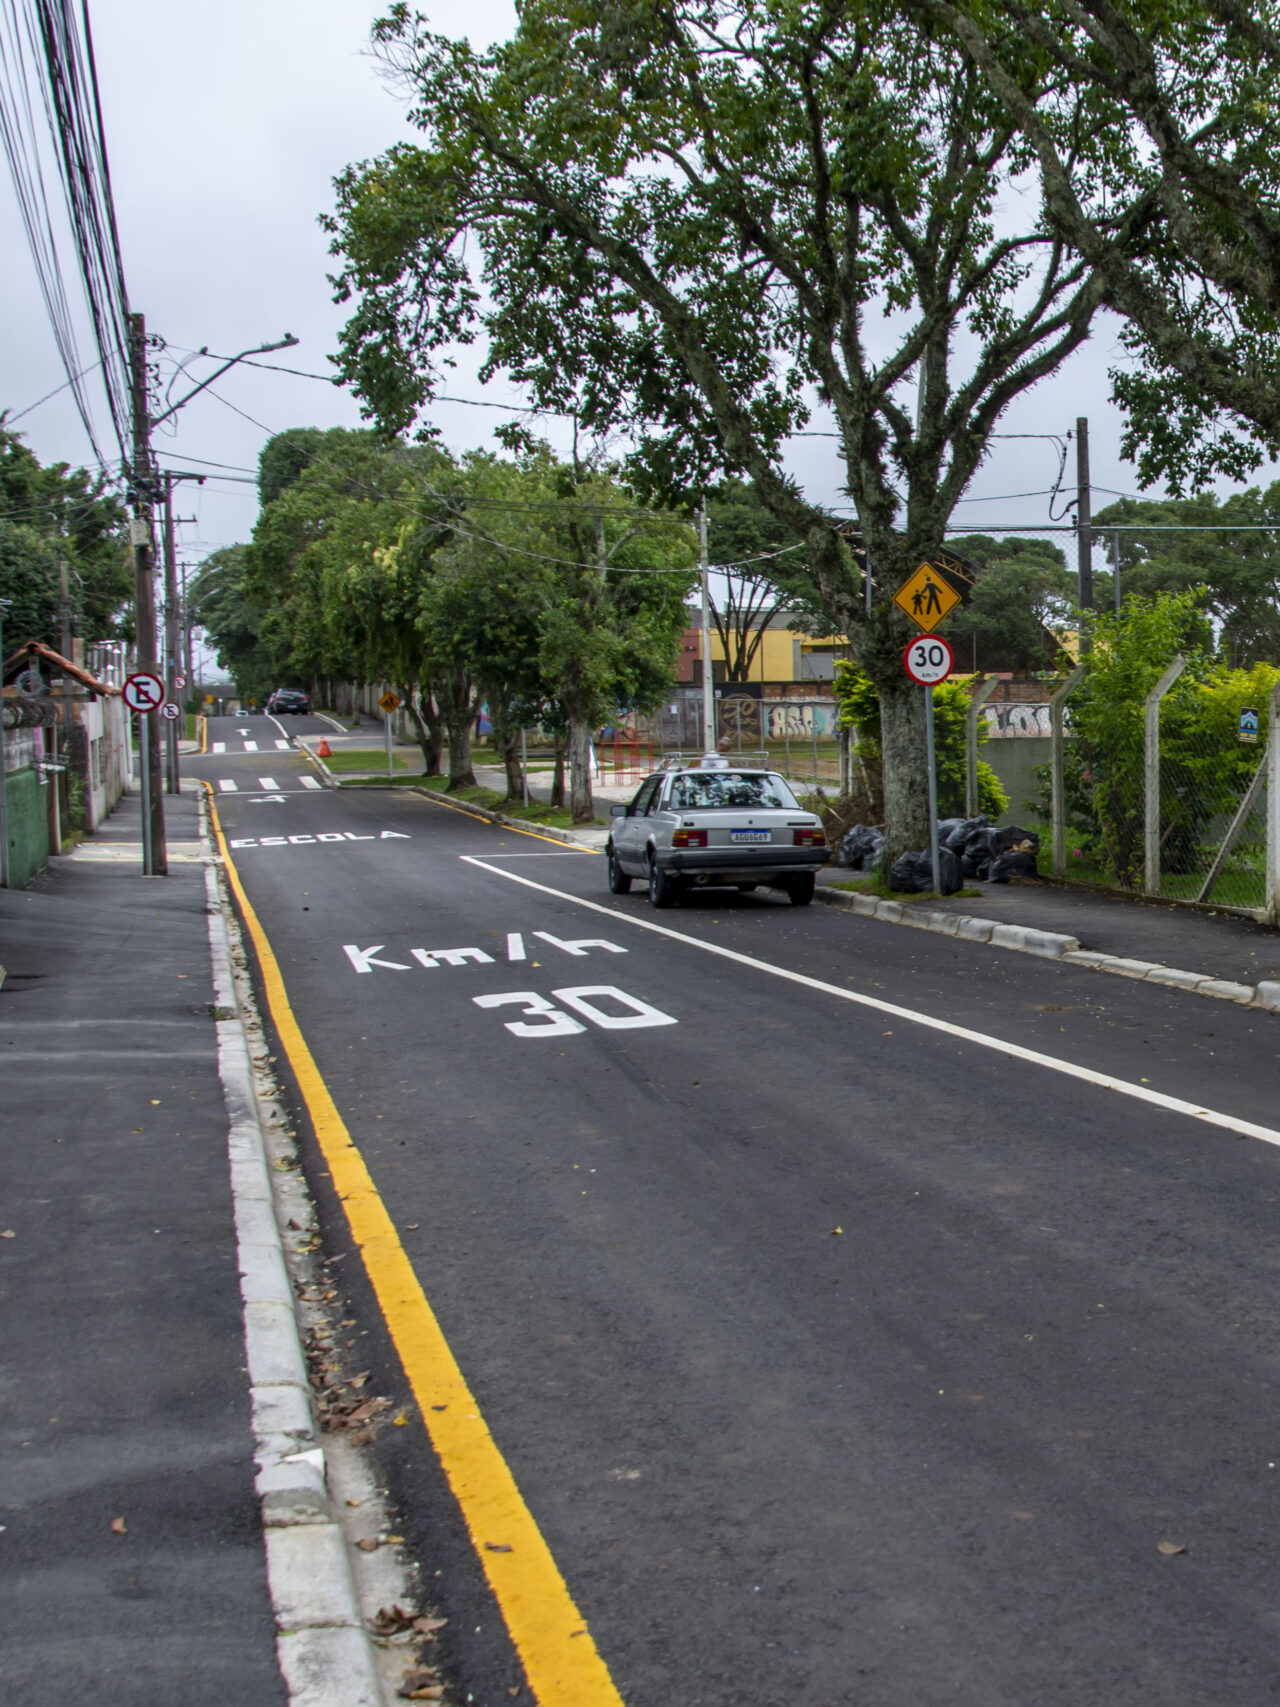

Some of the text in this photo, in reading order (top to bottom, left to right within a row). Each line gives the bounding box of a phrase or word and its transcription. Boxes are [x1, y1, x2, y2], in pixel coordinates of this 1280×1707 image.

[914, 645, 944, 667] 30
[135, 681, 151, 704] E
[230, 830, 412, 849] ESCOLA
[472, 985, 679, 1038] 30
